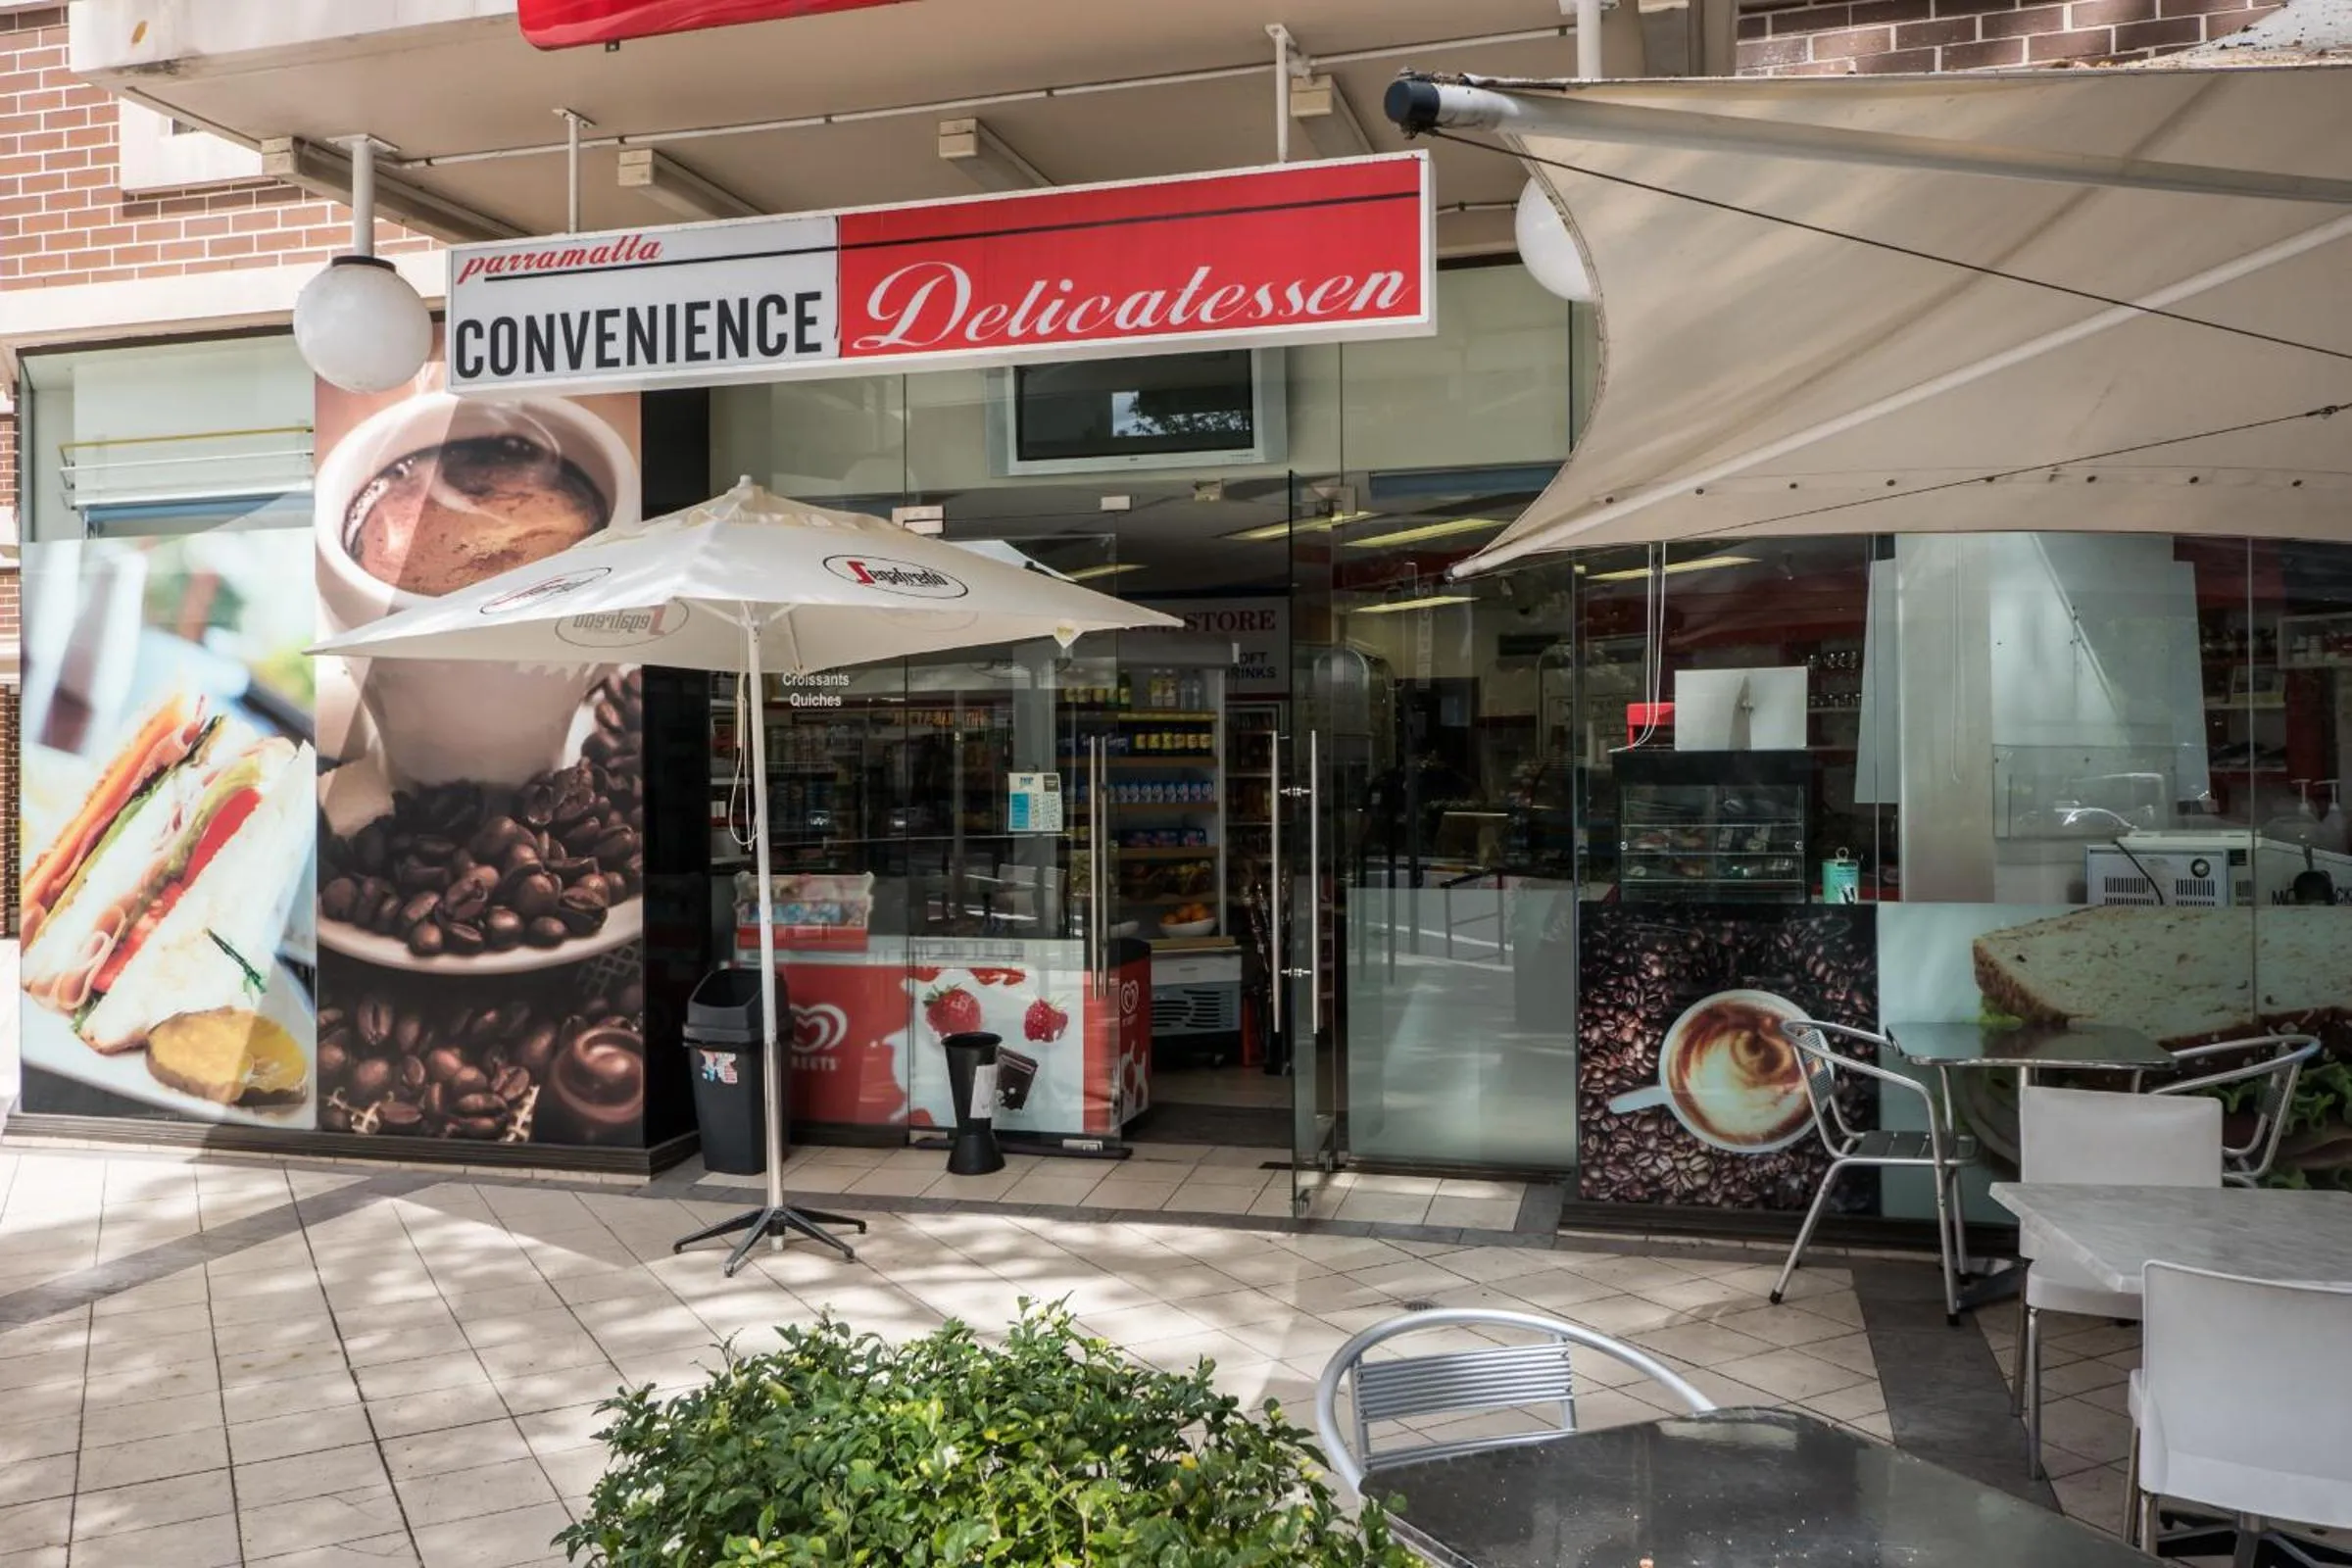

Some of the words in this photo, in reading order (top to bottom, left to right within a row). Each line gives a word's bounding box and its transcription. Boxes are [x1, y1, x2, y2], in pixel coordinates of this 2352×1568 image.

[853, 261, 1410, 348] Delicatessen
[456, 291, 822, 378] CONVENIENCE
[847, 561, 949, 586] Segafredo
[1183, 610, 1276, 633] STORE
[1239, 651, 1267, 664] OFT
[782, 673, 850, 686] Croissants
[790, 693, 842, 708] Quiches
